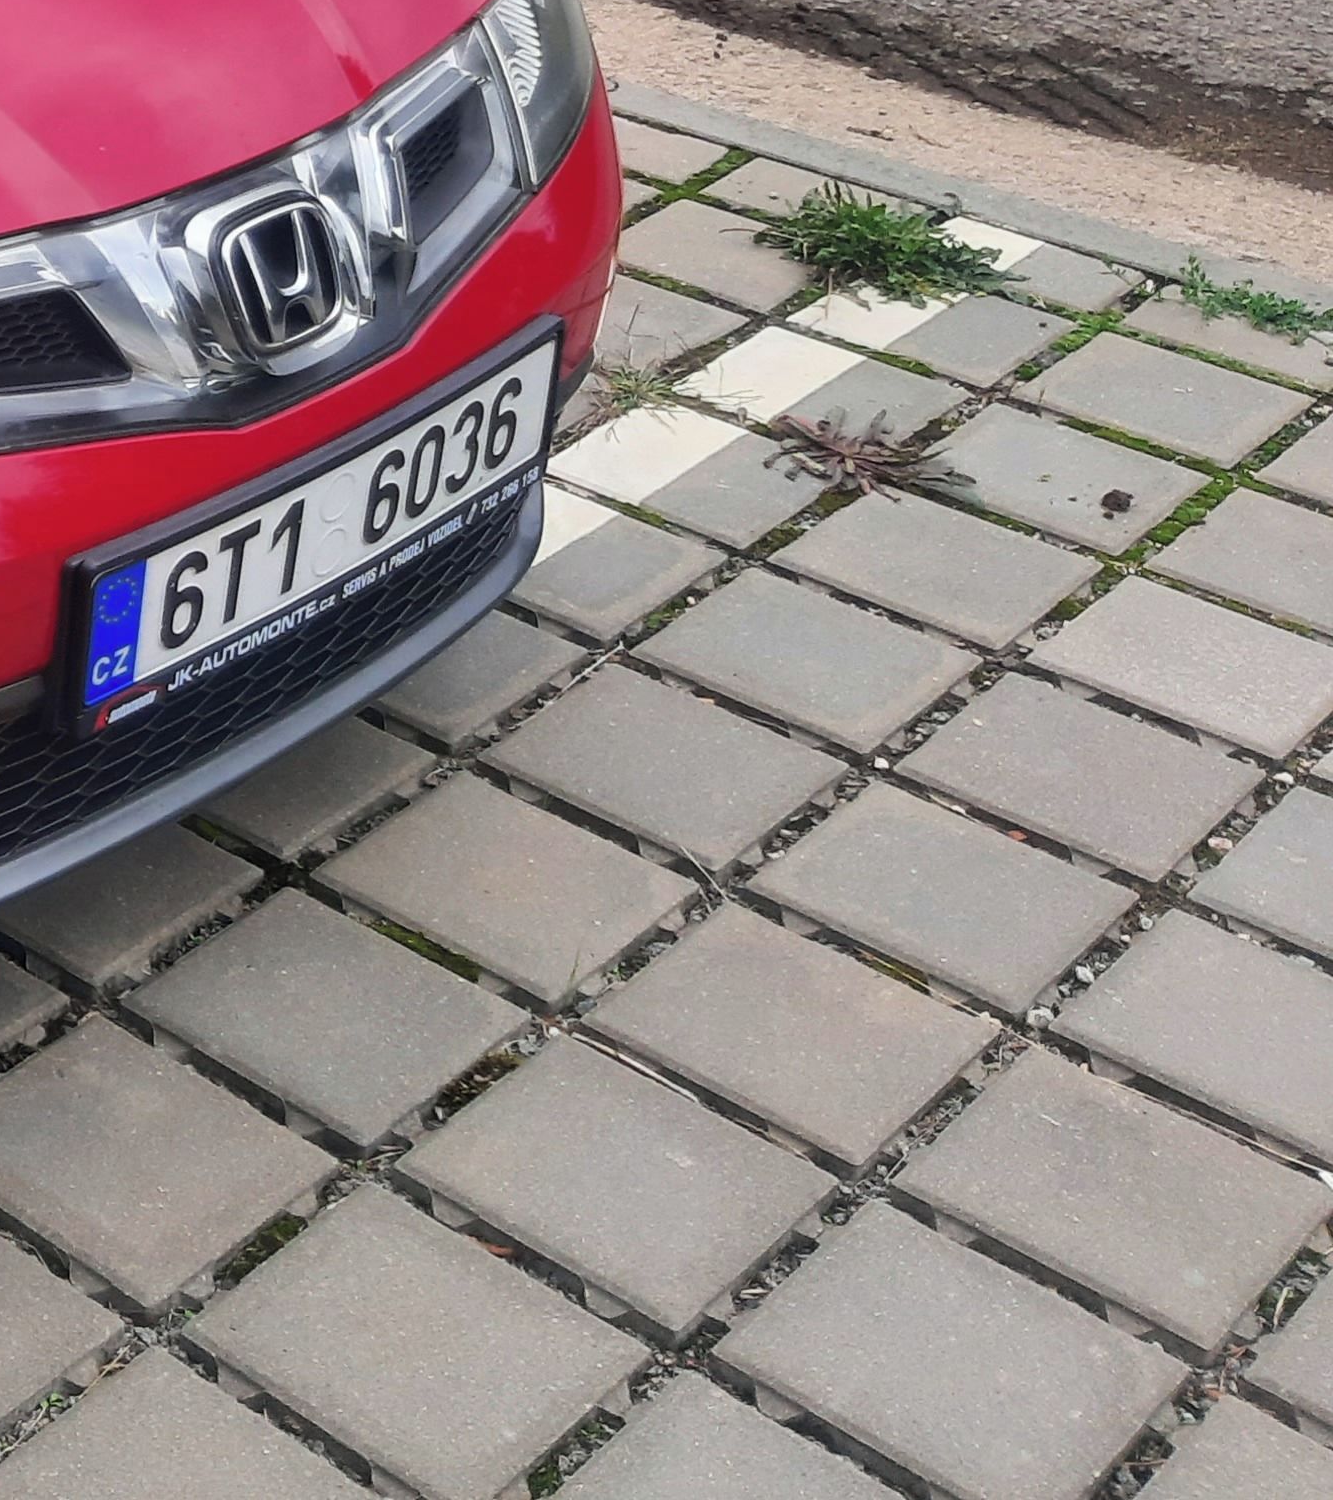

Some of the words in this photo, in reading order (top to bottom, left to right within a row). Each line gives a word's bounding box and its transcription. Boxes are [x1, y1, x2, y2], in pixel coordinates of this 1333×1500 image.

[159, 498, 306, 650] 6T1
[362, 377, 523, 544] 6036
[91, 644, 131, 686] CZ
[167, 594, 336, 692] JK-AUTOMONTE.cz
[378, 560, 387, 578] A
